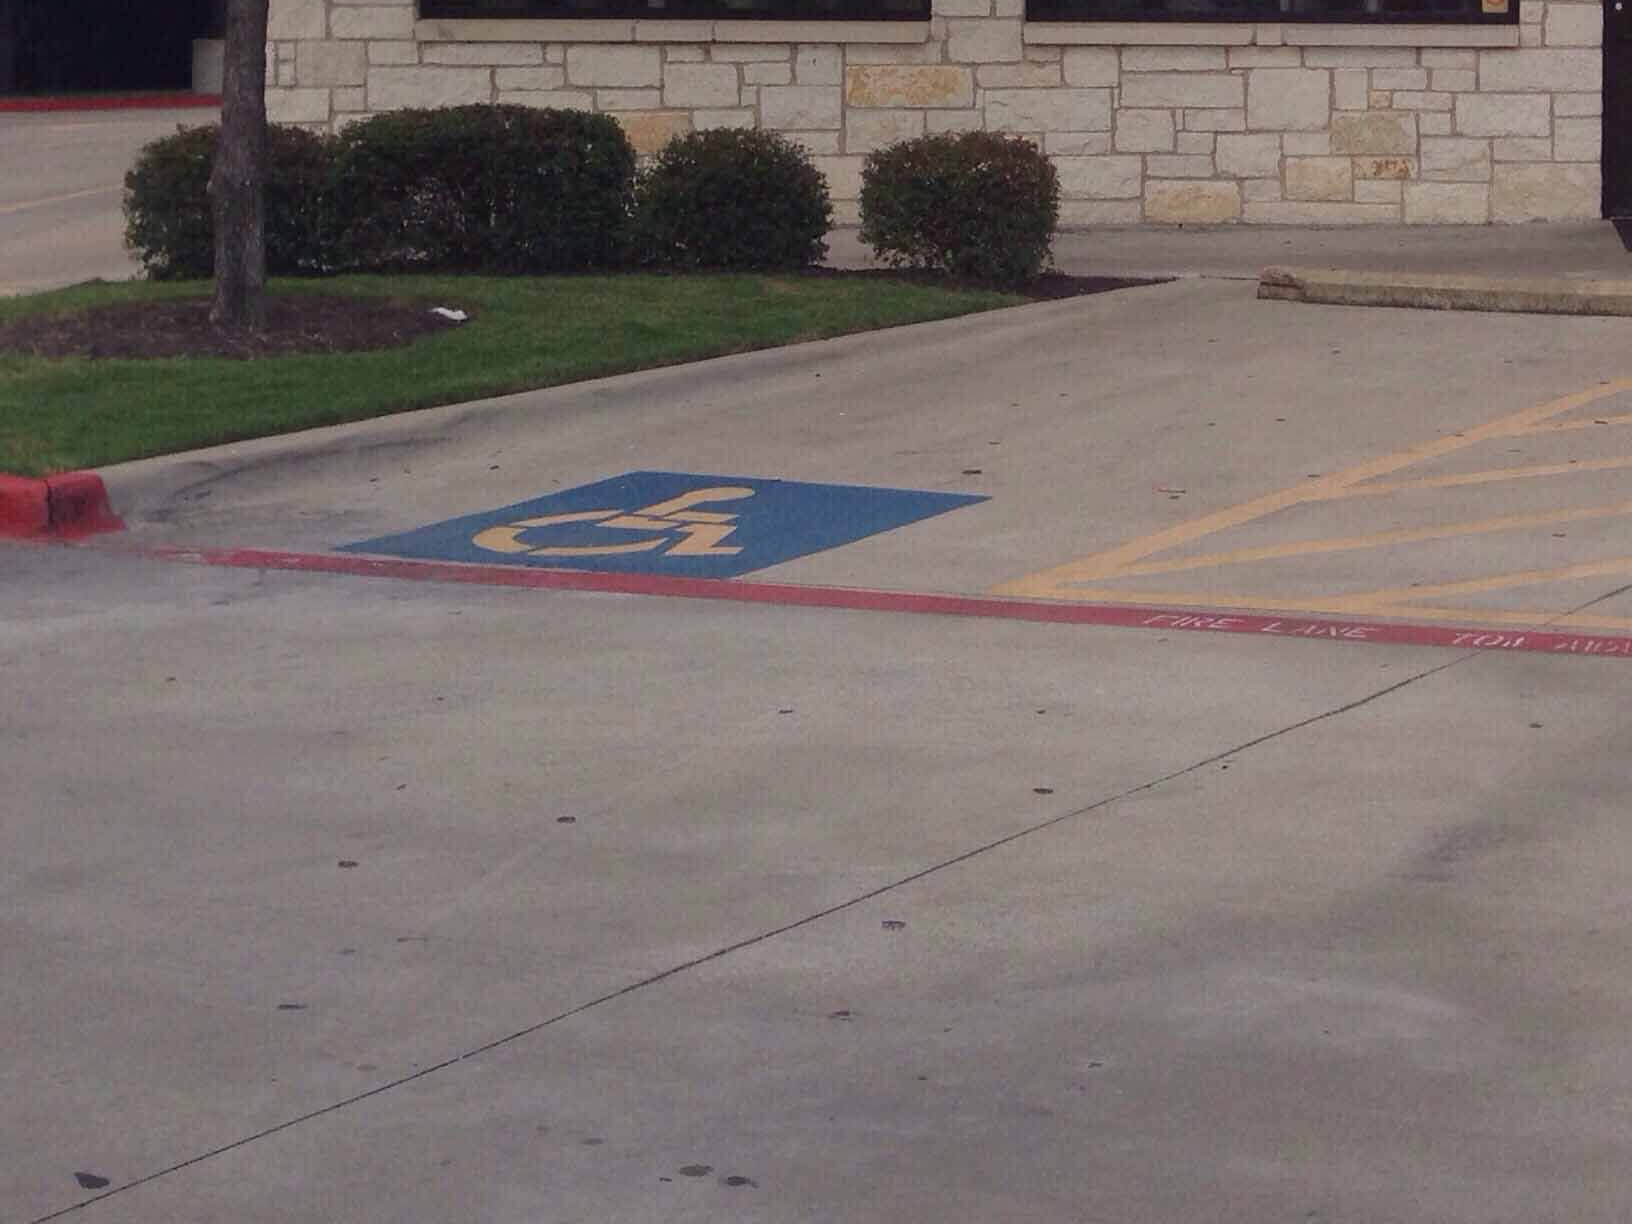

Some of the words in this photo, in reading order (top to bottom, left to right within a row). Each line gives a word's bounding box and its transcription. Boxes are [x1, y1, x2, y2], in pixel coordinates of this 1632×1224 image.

[1143, 613, 1246, 629] FIRE
[1260, 622, 1379, 639] LANE
[1451, 631, 1528, 650] TOW
